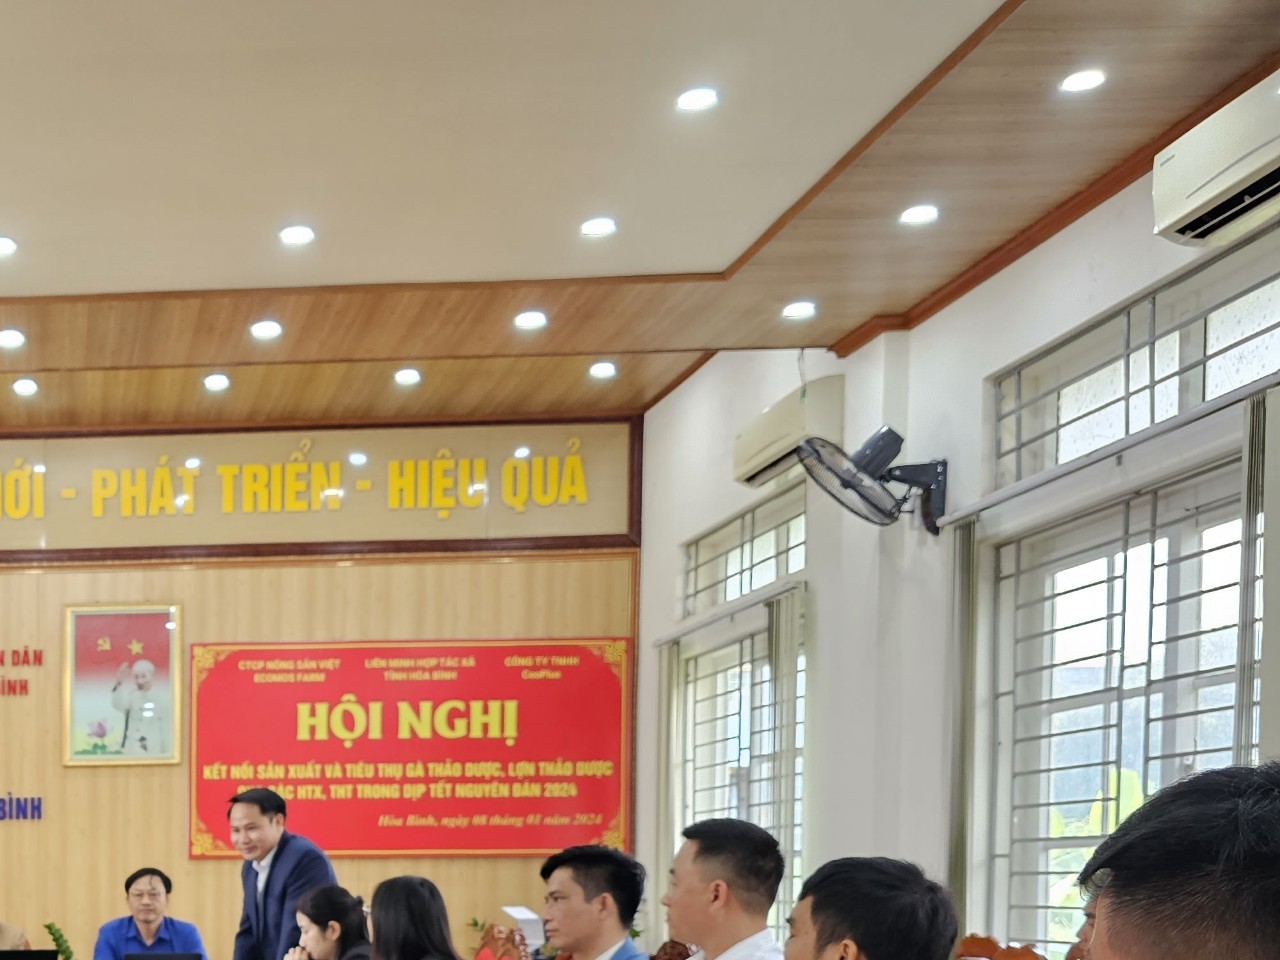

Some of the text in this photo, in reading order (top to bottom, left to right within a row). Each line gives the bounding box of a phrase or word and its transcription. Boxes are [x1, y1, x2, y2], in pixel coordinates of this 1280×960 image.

[92, 455, 200, 518] PHÁT
[217, 439, 341, 514] TRIỂN
[388, 448, 485, 519] HIỆU
[502, 437, 588, 512] QUẢ
[11, 645, 44, 667] DÂN
[296, 693, 519, 748] HỘI NGHỊ
[202, 761, 227, 780] KẾT
[256, 760, 285, 779] SẢN
[324, 761, 343, 778] VÀ
[344, 760, 374, 778] TIÊU
[356, 784, 400, 799] TRONG
[428, 779, 453, 798] TẾT
[454, 780, 510, 798] NGUYÊN
[543, 782, 578, 797] 2024
